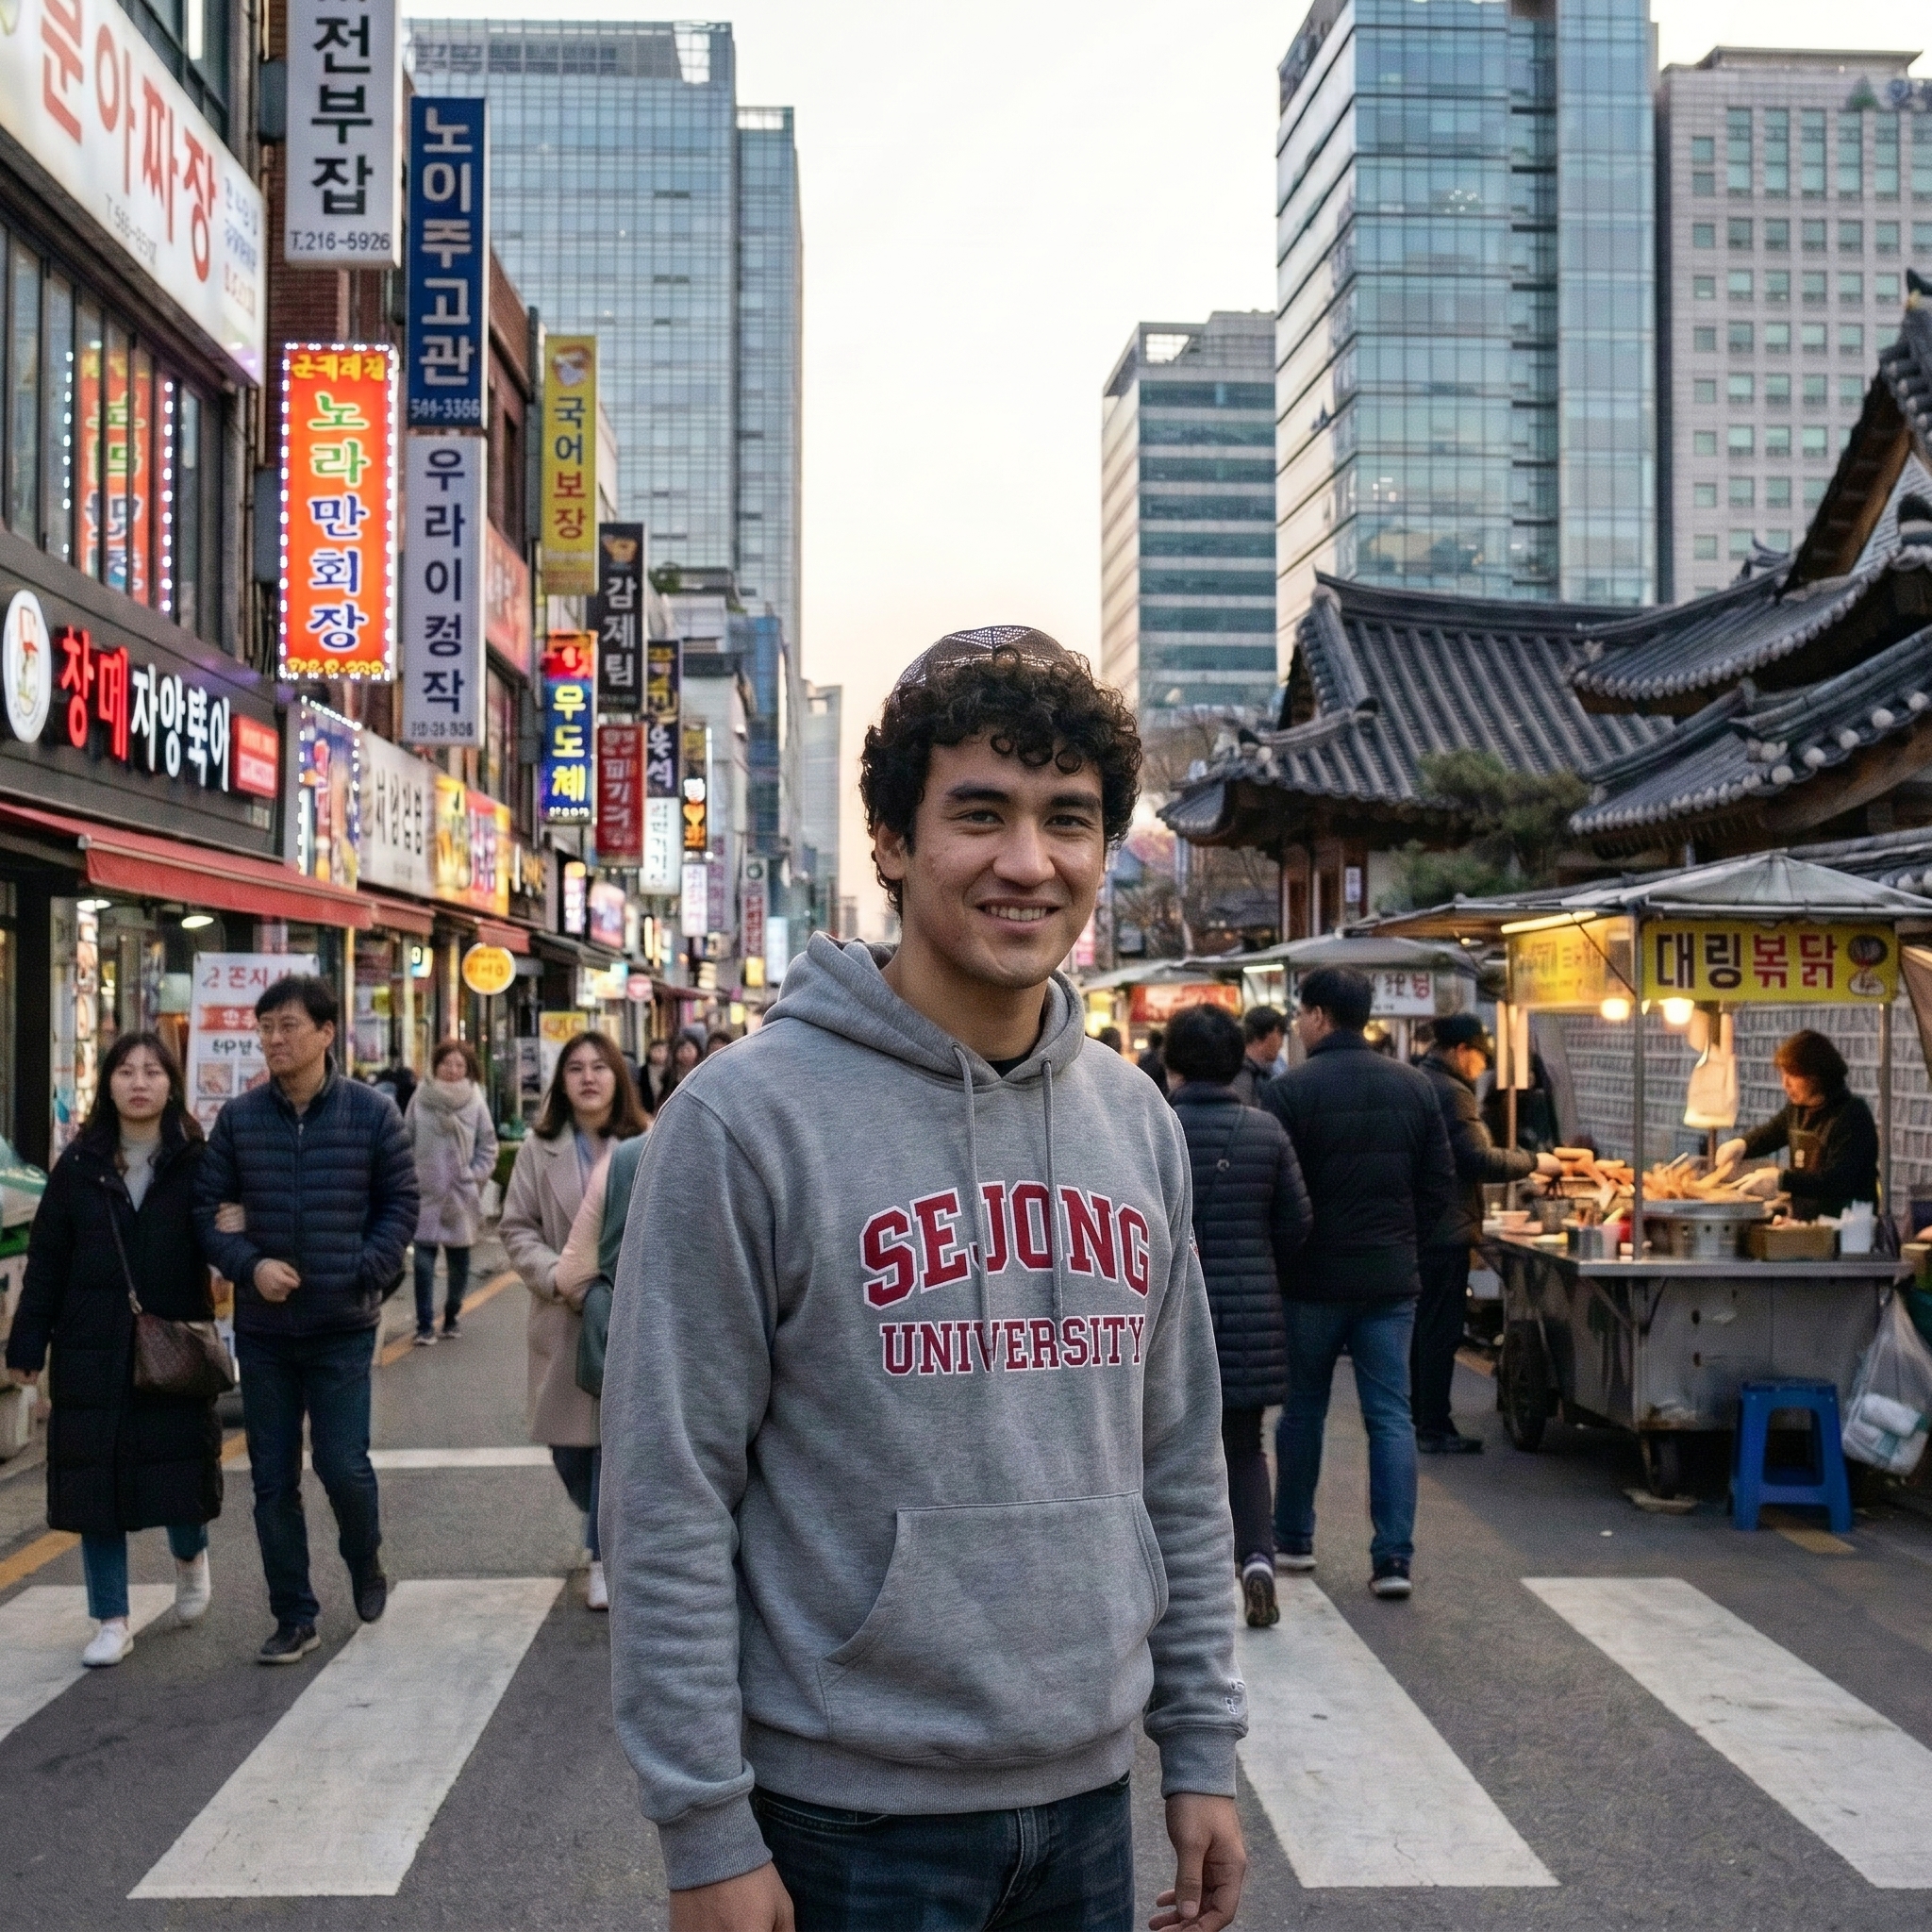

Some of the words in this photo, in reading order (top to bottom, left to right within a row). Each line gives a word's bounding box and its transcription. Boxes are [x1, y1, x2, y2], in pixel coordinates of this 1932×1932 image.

[310, 0, 374, 215] 전부잡
[290, 231, 391, 251] T.216-5926
[307, 391, 370, 652] 노라만회장
[554, 396, 587, 540] 국어보장
[859, 1180, 1149, 1310] SEJONG
[879, 1314, 1145, 1375] UNIVERSITY
